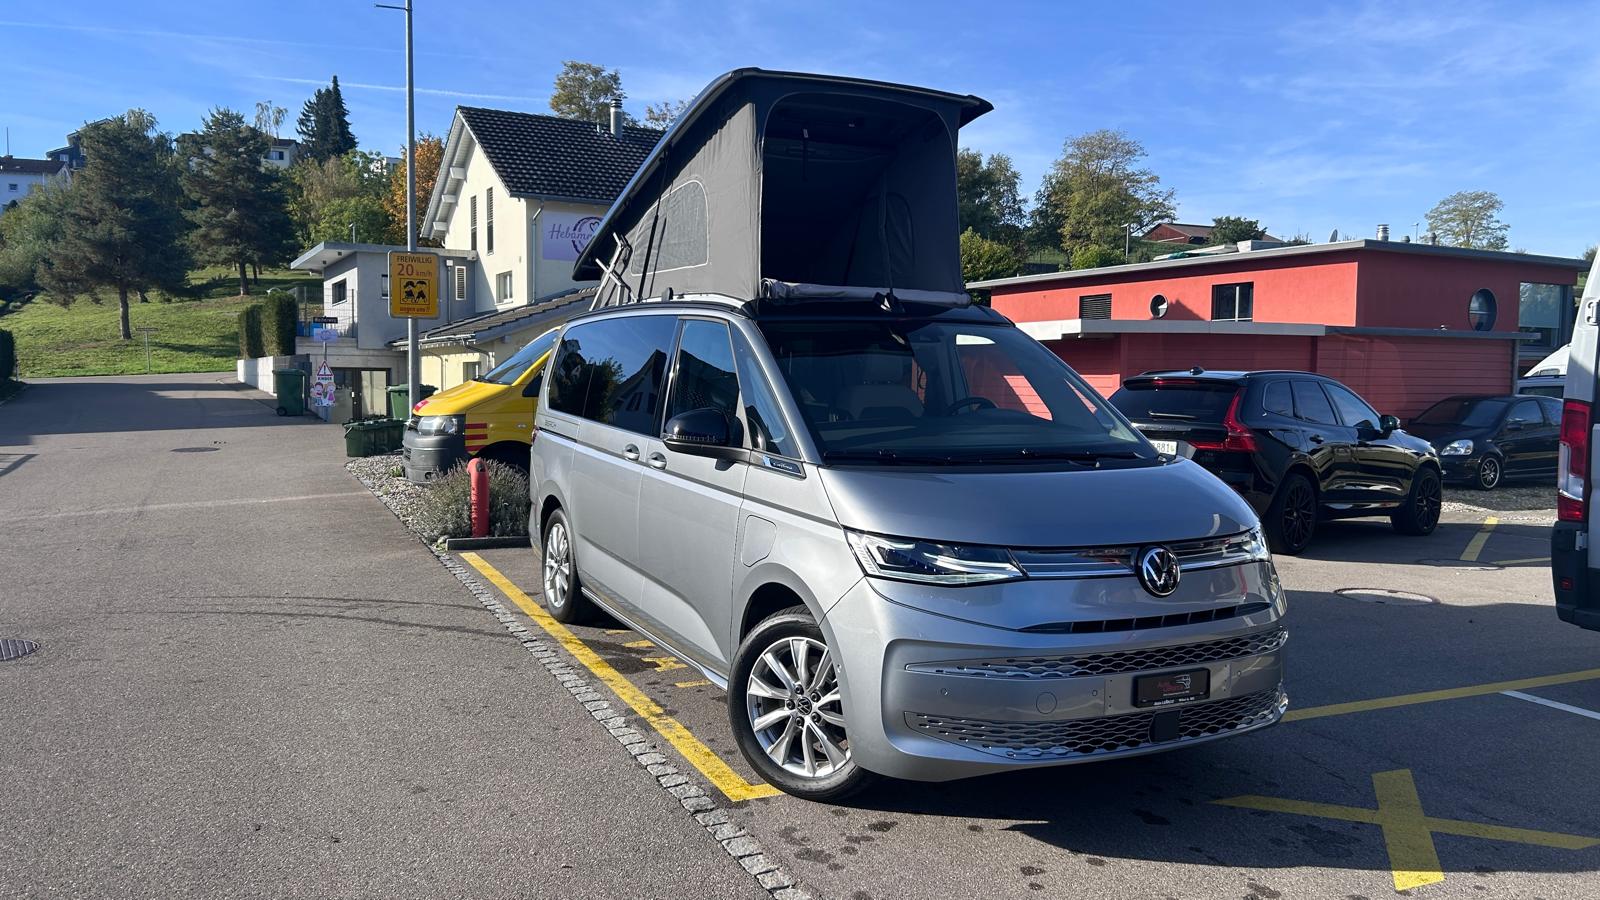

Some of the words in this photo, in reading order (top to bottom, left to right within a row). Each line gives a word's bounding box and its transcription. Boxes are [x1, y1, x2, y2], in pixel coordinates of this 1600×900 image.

[397, 255, 433, 264] FREIWILLIG
[398, 263, 414, 276] 20
[416, 270, 433, 278] km/h
